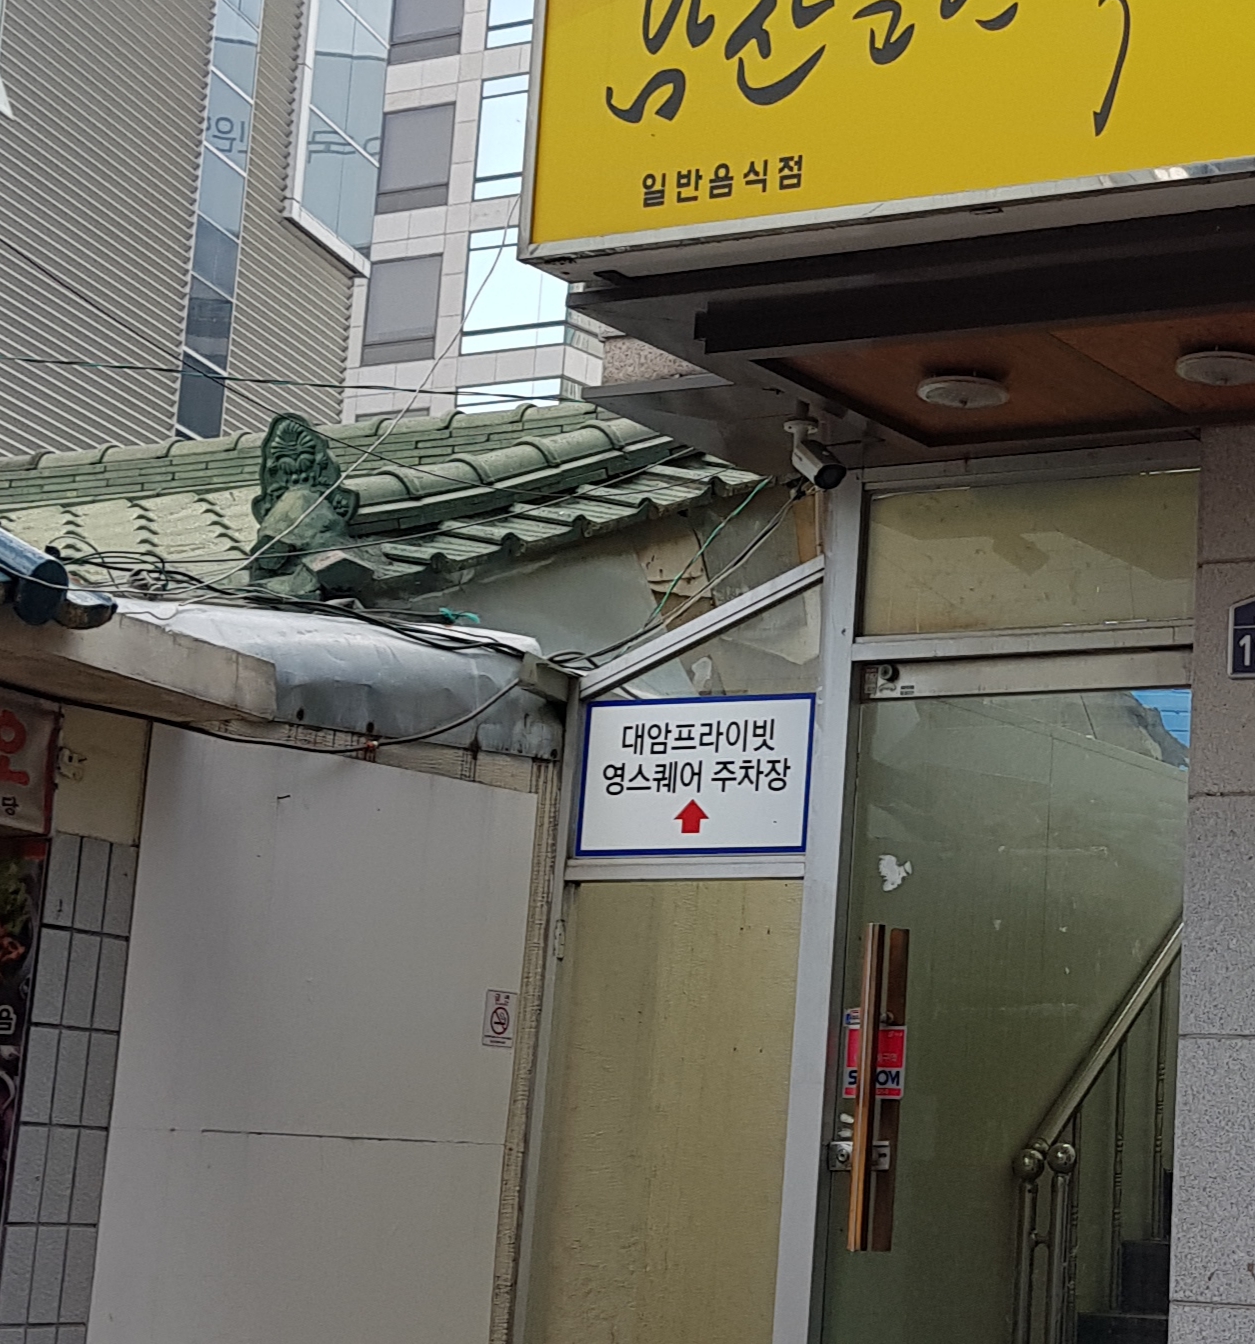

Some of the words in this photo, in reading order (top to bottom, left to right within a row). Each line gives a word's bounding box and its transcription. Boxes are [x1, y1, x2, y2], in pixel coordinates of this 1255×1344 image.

[641, 154, 804, 208] 일반음식점
[621, 718, 775, 756] 대암프라이빗
[602, 760, 703, 796] 영스퀘어
[710, 757, 791, 792] 주차장
[847, 1070, 900, 1086] SOM
